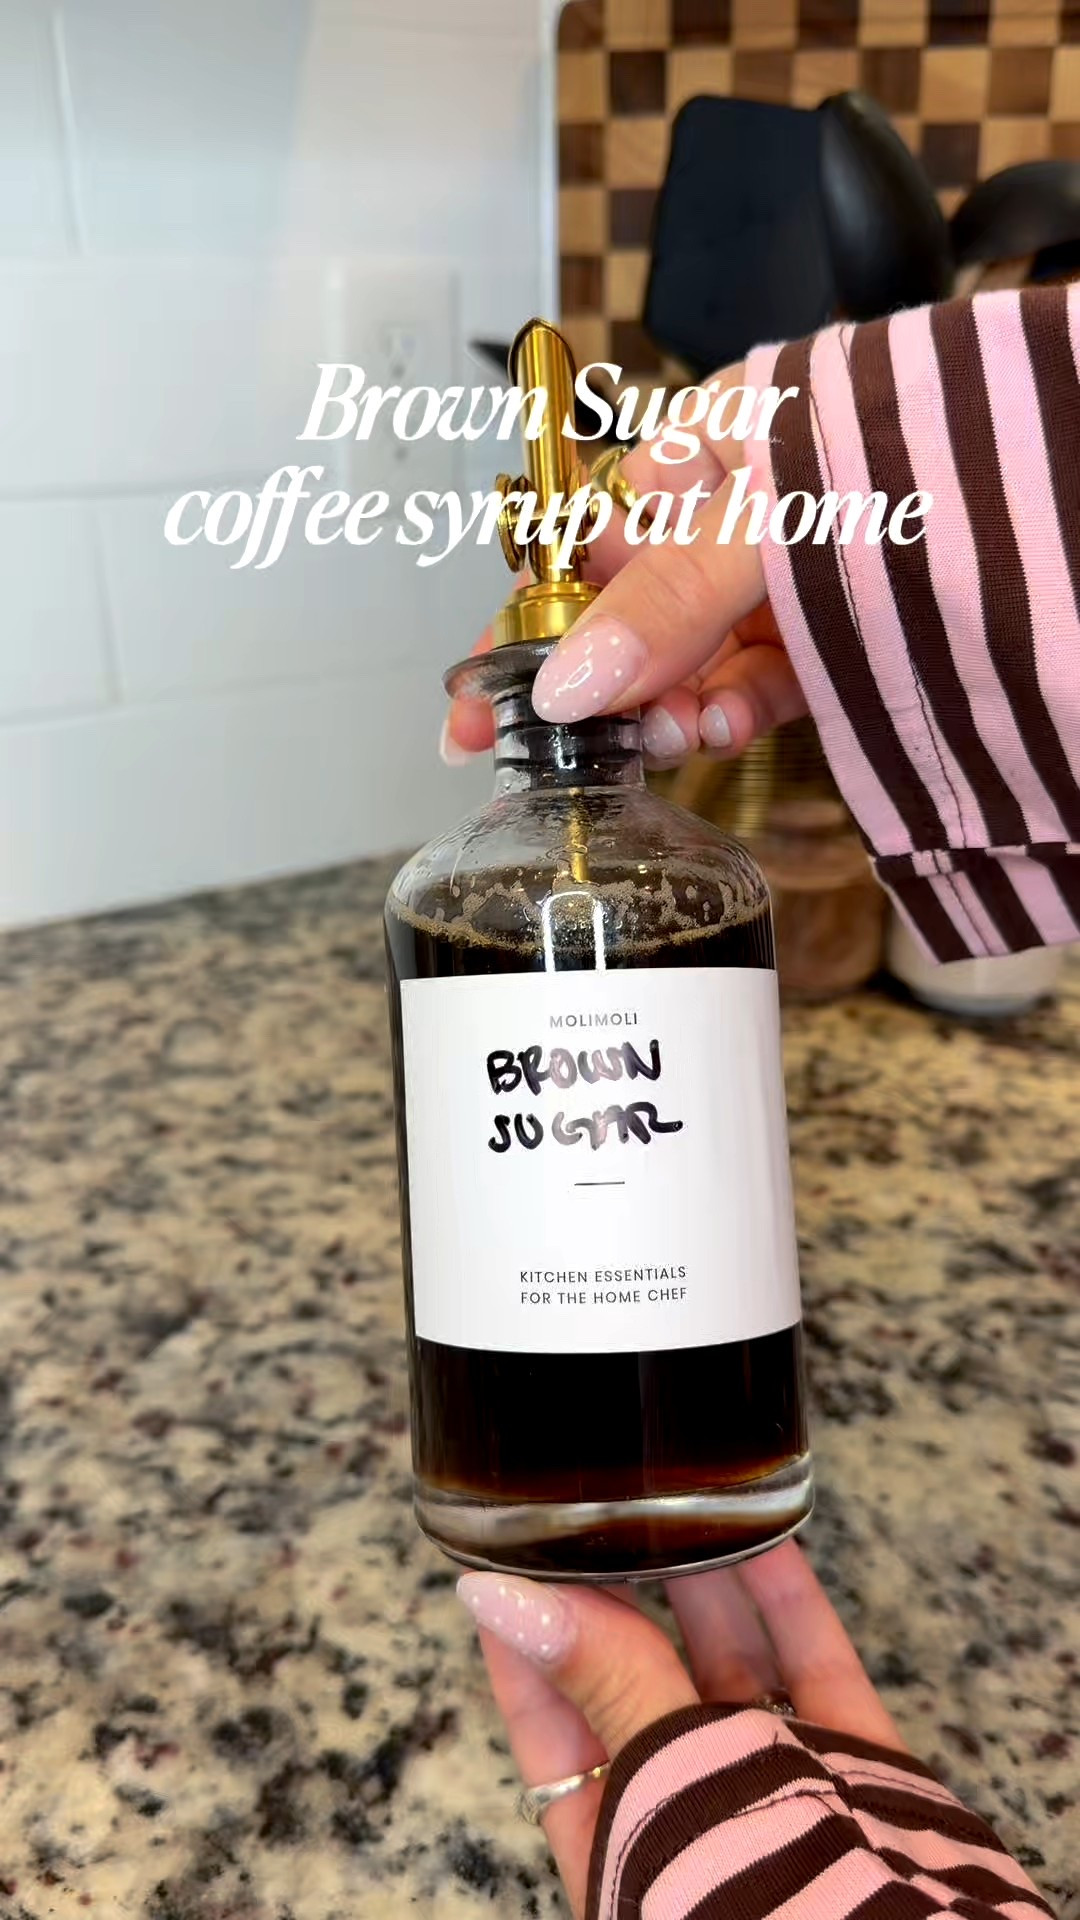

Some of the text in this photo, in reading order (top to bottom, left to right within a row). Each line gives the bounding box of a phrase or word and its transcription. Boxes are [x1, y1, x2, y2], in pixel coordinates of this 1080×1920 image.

[549, 1011, 638, 1028] MOLIMOLI
[487, 1039, 662, 1096] BROWN
[488, 1101, 684, 1153] SUGAR
[520, 1266, 687, 1283] KITCHEN ESSENTIALS
[520, 1287, 688, 1304] FOR THE HOME CHEF
